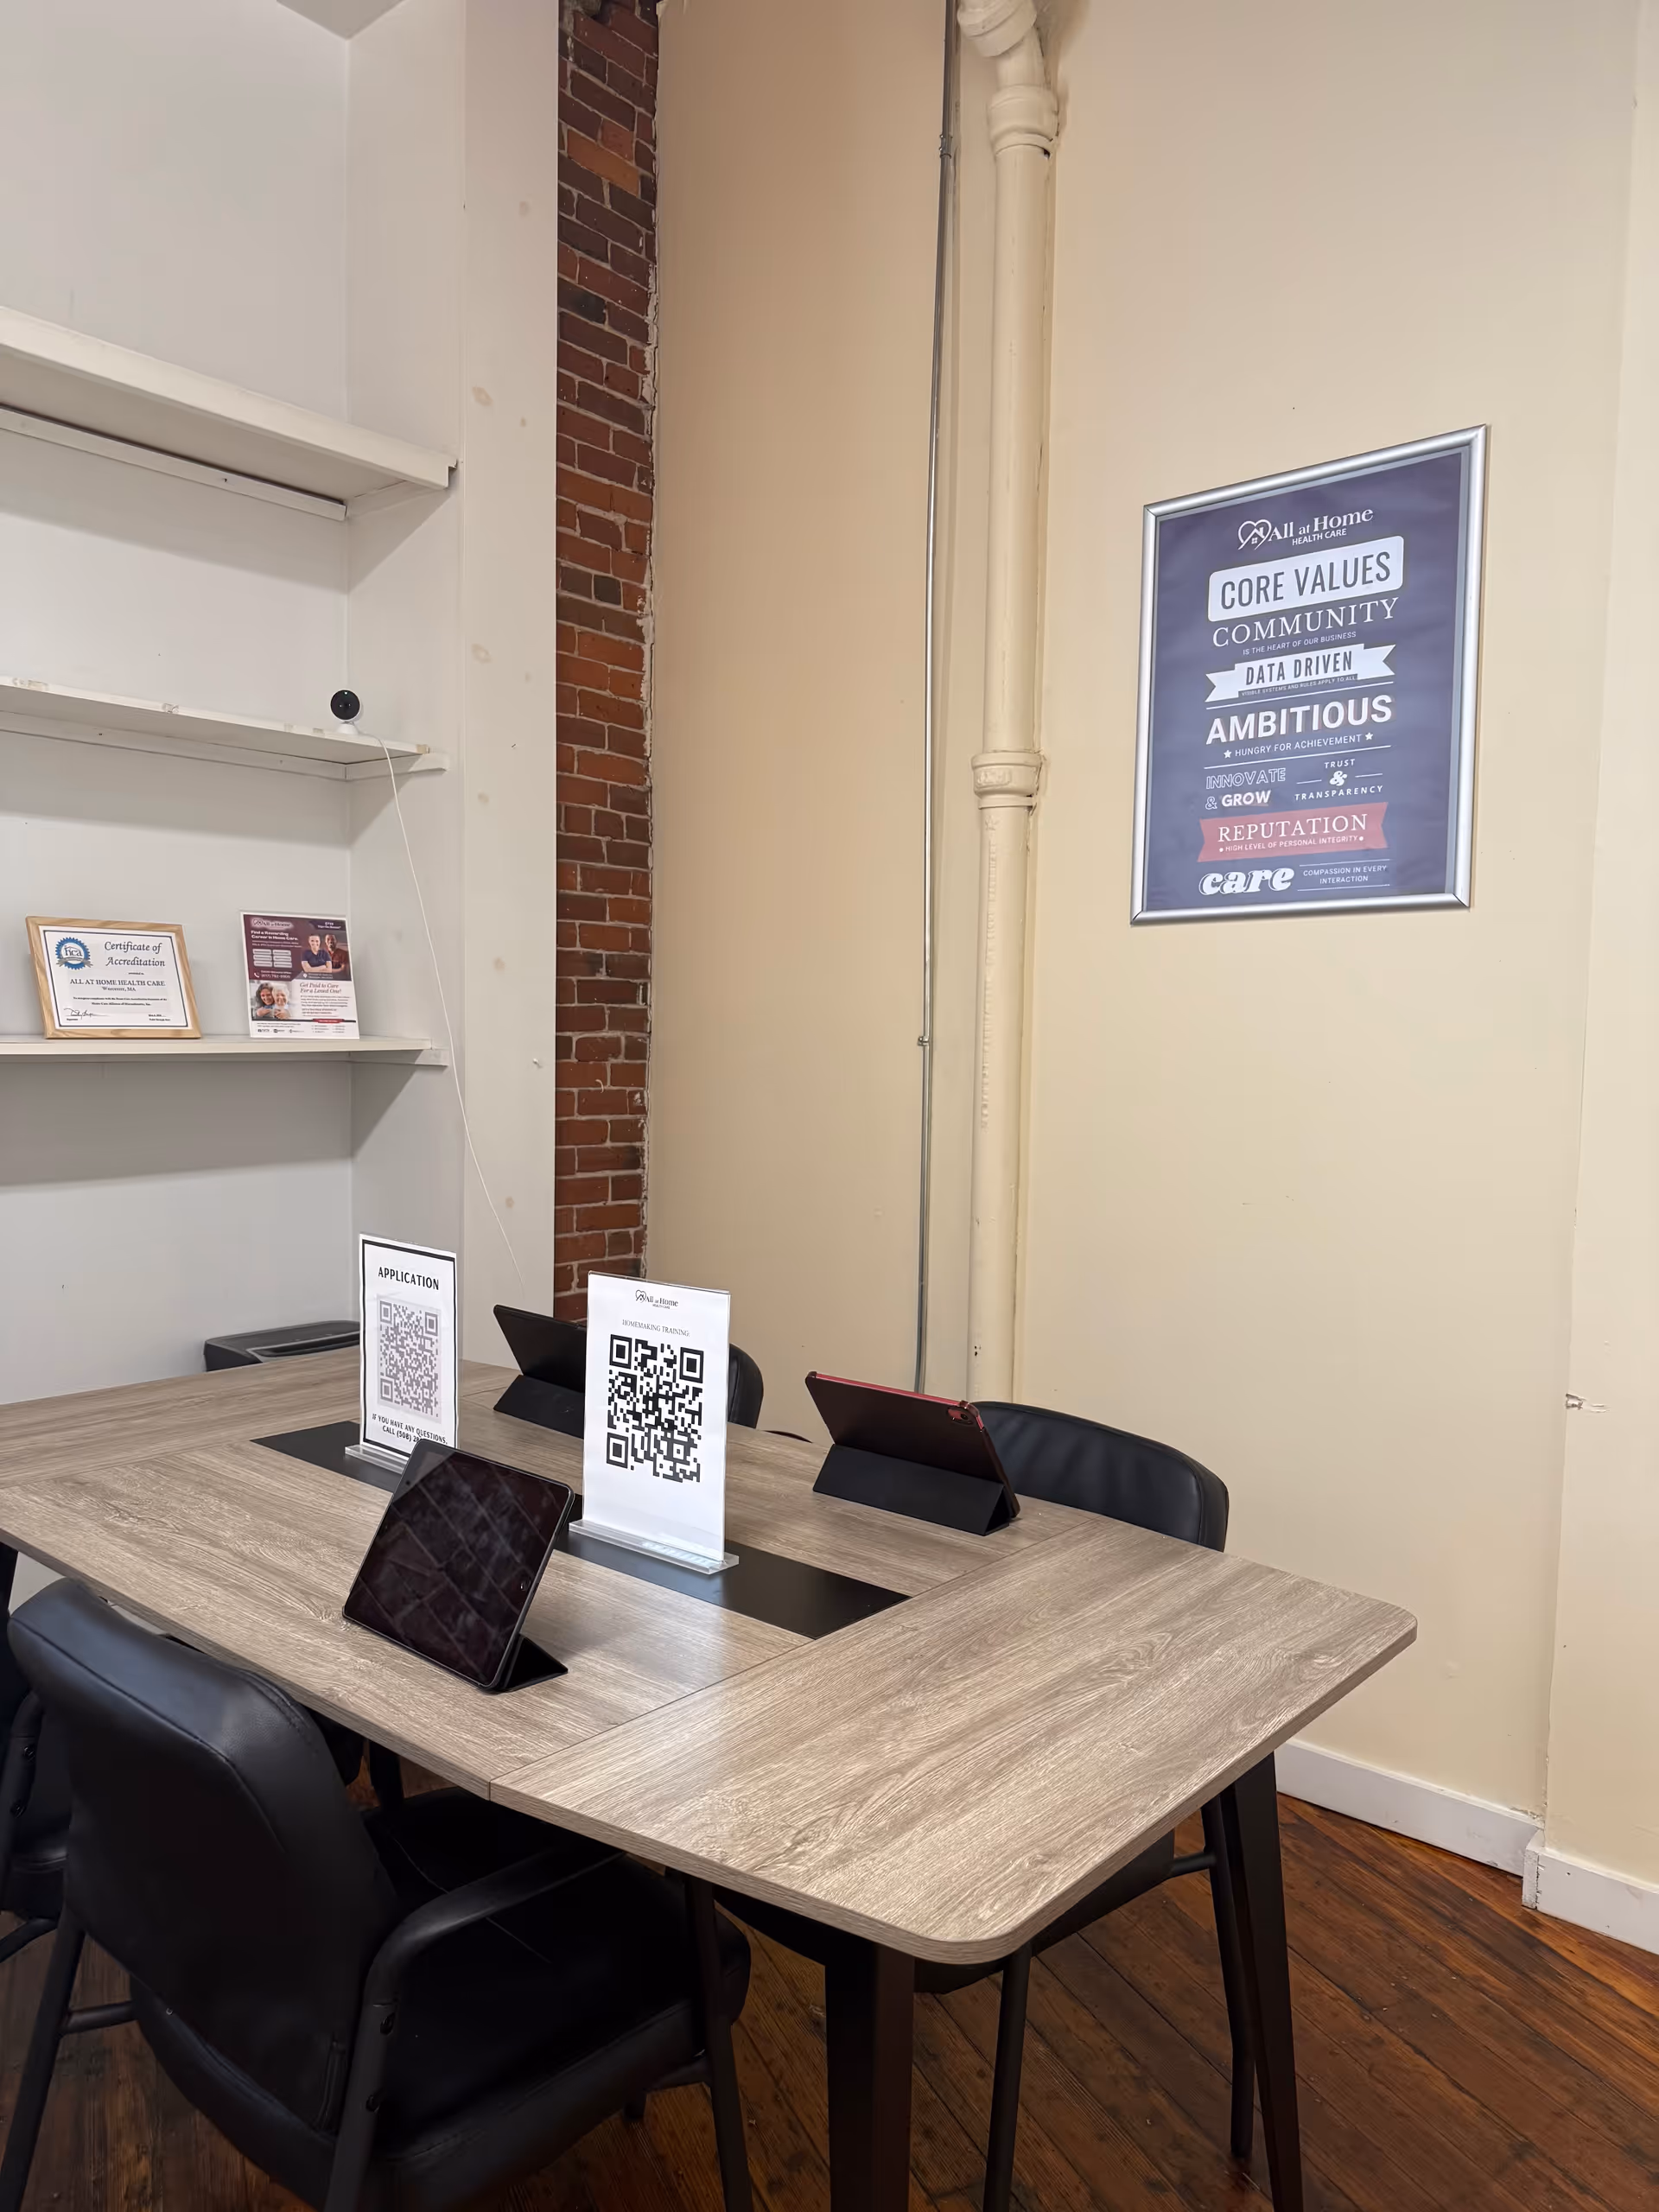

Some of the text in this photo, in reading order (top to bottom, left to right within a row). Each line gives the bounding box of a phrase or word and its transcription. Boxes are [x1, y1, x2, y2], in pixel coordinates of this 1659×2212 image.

[1268, 508, 1373, 542] All at Home
[1292, 528, 1347, 546] HEALTH CARE
[1221, 551, 1390, 610] CORE VALUES
[1212, 597, 1399, 647] COMMUNITY
[1267, 643, 1290, 652] HEART
[1304, 637, 1319, 645] OUR
[1320, 632, 1357, 643] BUSINESS
[1246, 650, 1352, 686] DATA DRIVEN
[1262, 685, 1287, 694] SYSTEMS
[1205, 694, 1393, 745] AMBITIOUS
[1235, 734, 1362, 757] HUNGRY FOR ACHIEVEMENT
[1324, 758, 1356, 769] TRUST
[1205, 767, 1287, 790] INNOVATE
[1330, 770, 1348, 786] &
[1205, 790, 1271, 810] & GROW
[1294, 785, 1383, 801] TRANSPARENCY
[1217, 813, 1368, 842] REPUTATION
[1244, 842, 1266, 850] LEVEL
[1279, 838, 1317, 848] PERSONAL
[1319, 835, 1357, 845] INTEGRITY
[1303, 867, 1351, 876] COMPASSION
[1363, 864, 1388, 874] EVERY
[1198, 868, 1294, 895] care
[1319, 875, 1369, 885] INTERACTION
[104, 941, 162, 954] Certificate of
[105, 957, 166, 967] Accreditation
[378, 1266, 440, 1290] APPLICATION
[659, 1298, 679, 1306] Home
[622, 1319, 661, 1332] HOMEMAKING
[378, 1414, 389, 1425] YOU
[390, 1418, 404, 1429] HAVE
[404, 1424, 416, 1433] ANY
[382, 1425, 395, 1435] CALL
[397, 1430, 411, 1441] (508)
